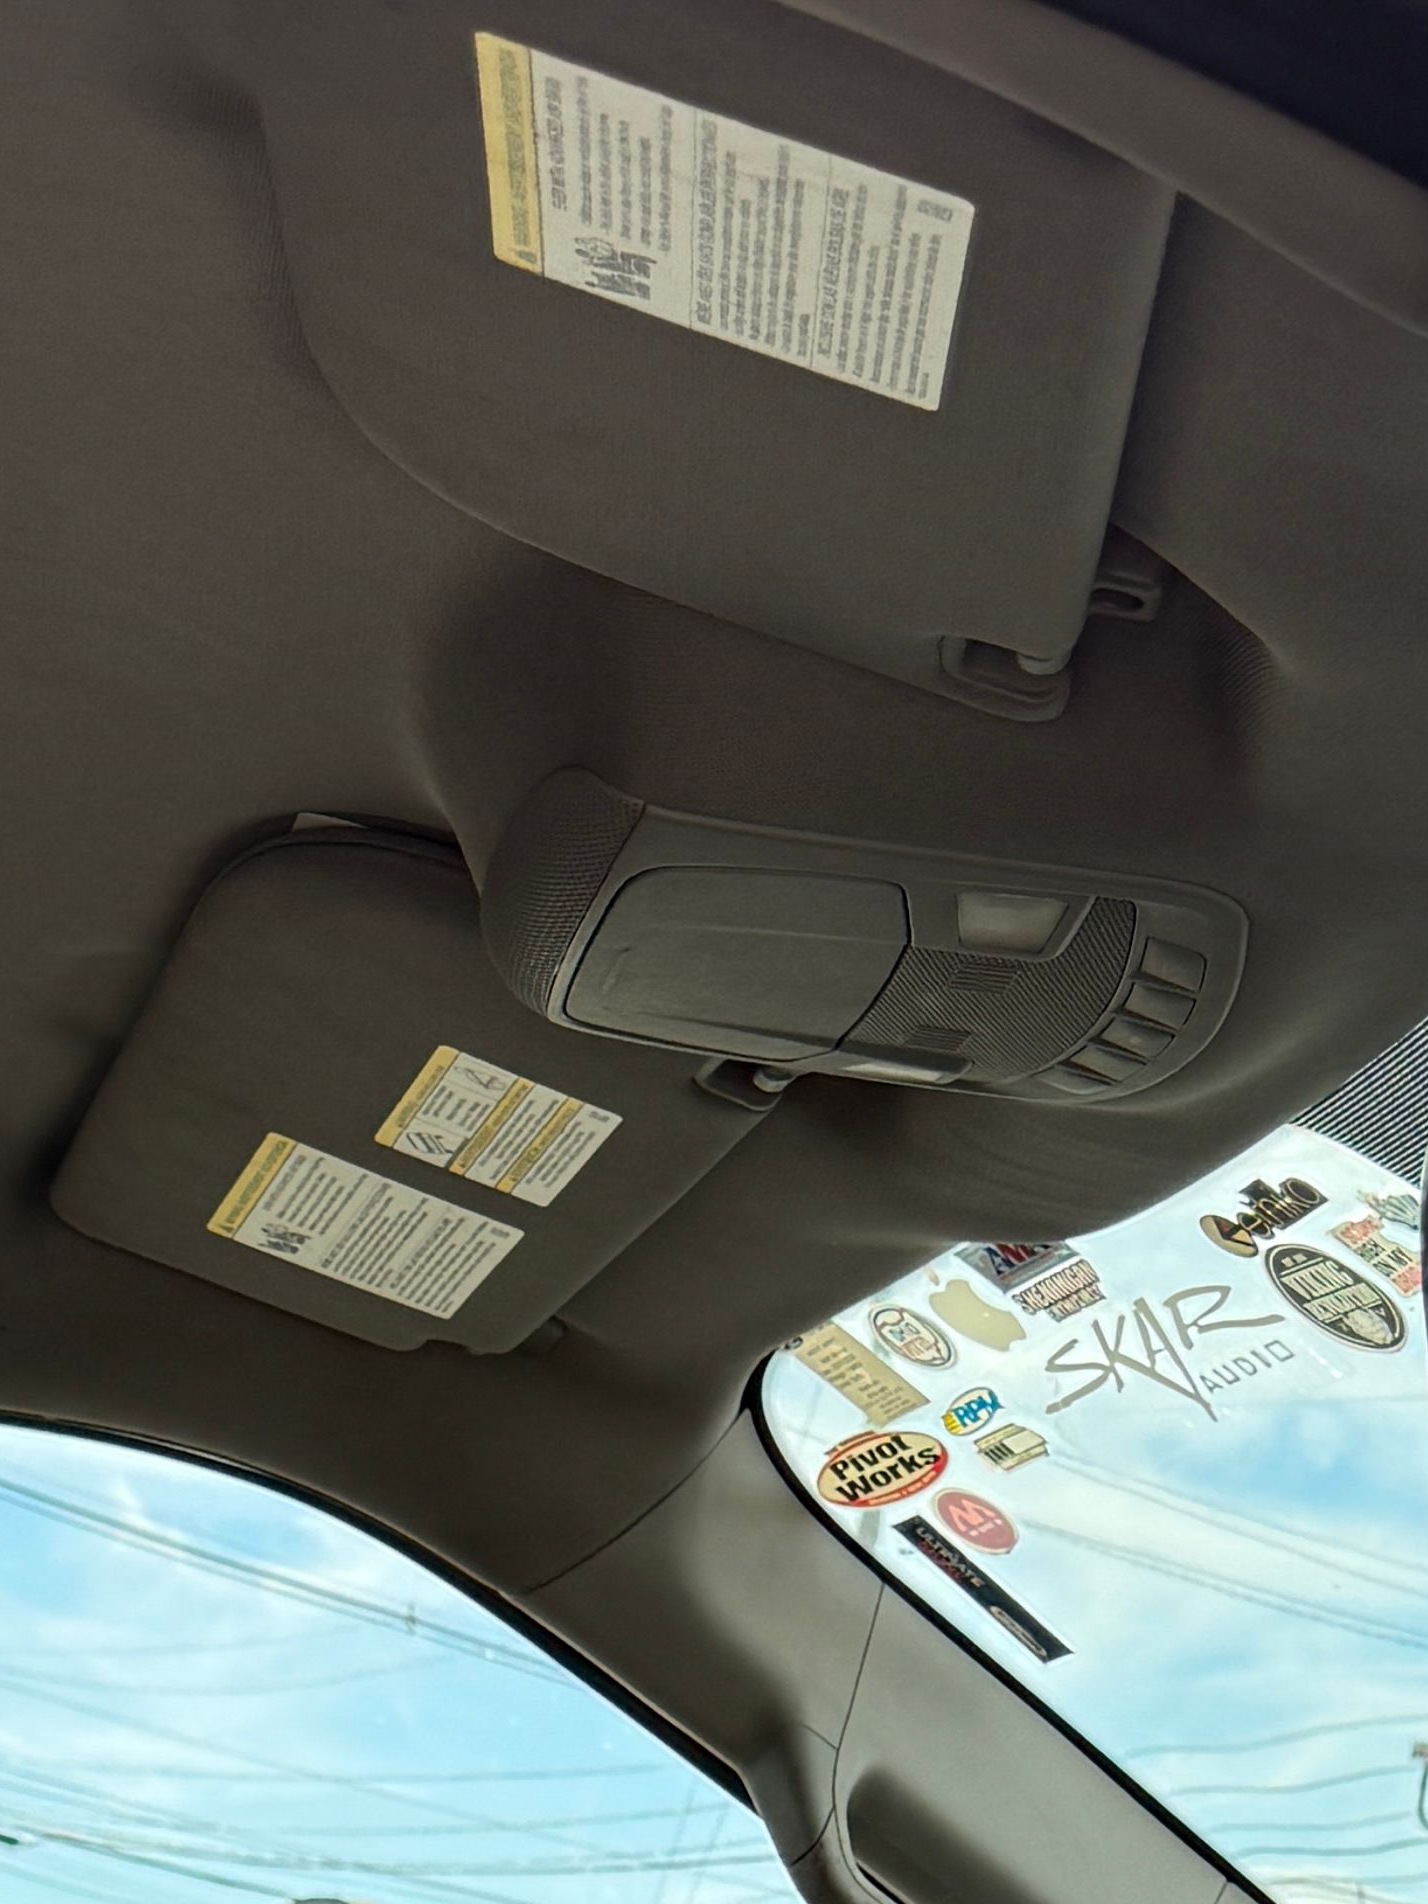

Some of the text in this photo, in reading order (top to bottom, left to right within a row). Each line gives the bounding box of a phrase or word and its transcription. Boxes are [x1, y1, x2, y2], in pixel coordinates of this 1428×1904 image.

[1280, 1261, 1354, 1300] VIKING
[1045, 1285, 1286, 1422] SKAR
[1199, 1340, 1295, 1394] AUDIO
[829, 1434, 911, 1481] Pivot
[835, 1447, 941, 1503] Works
